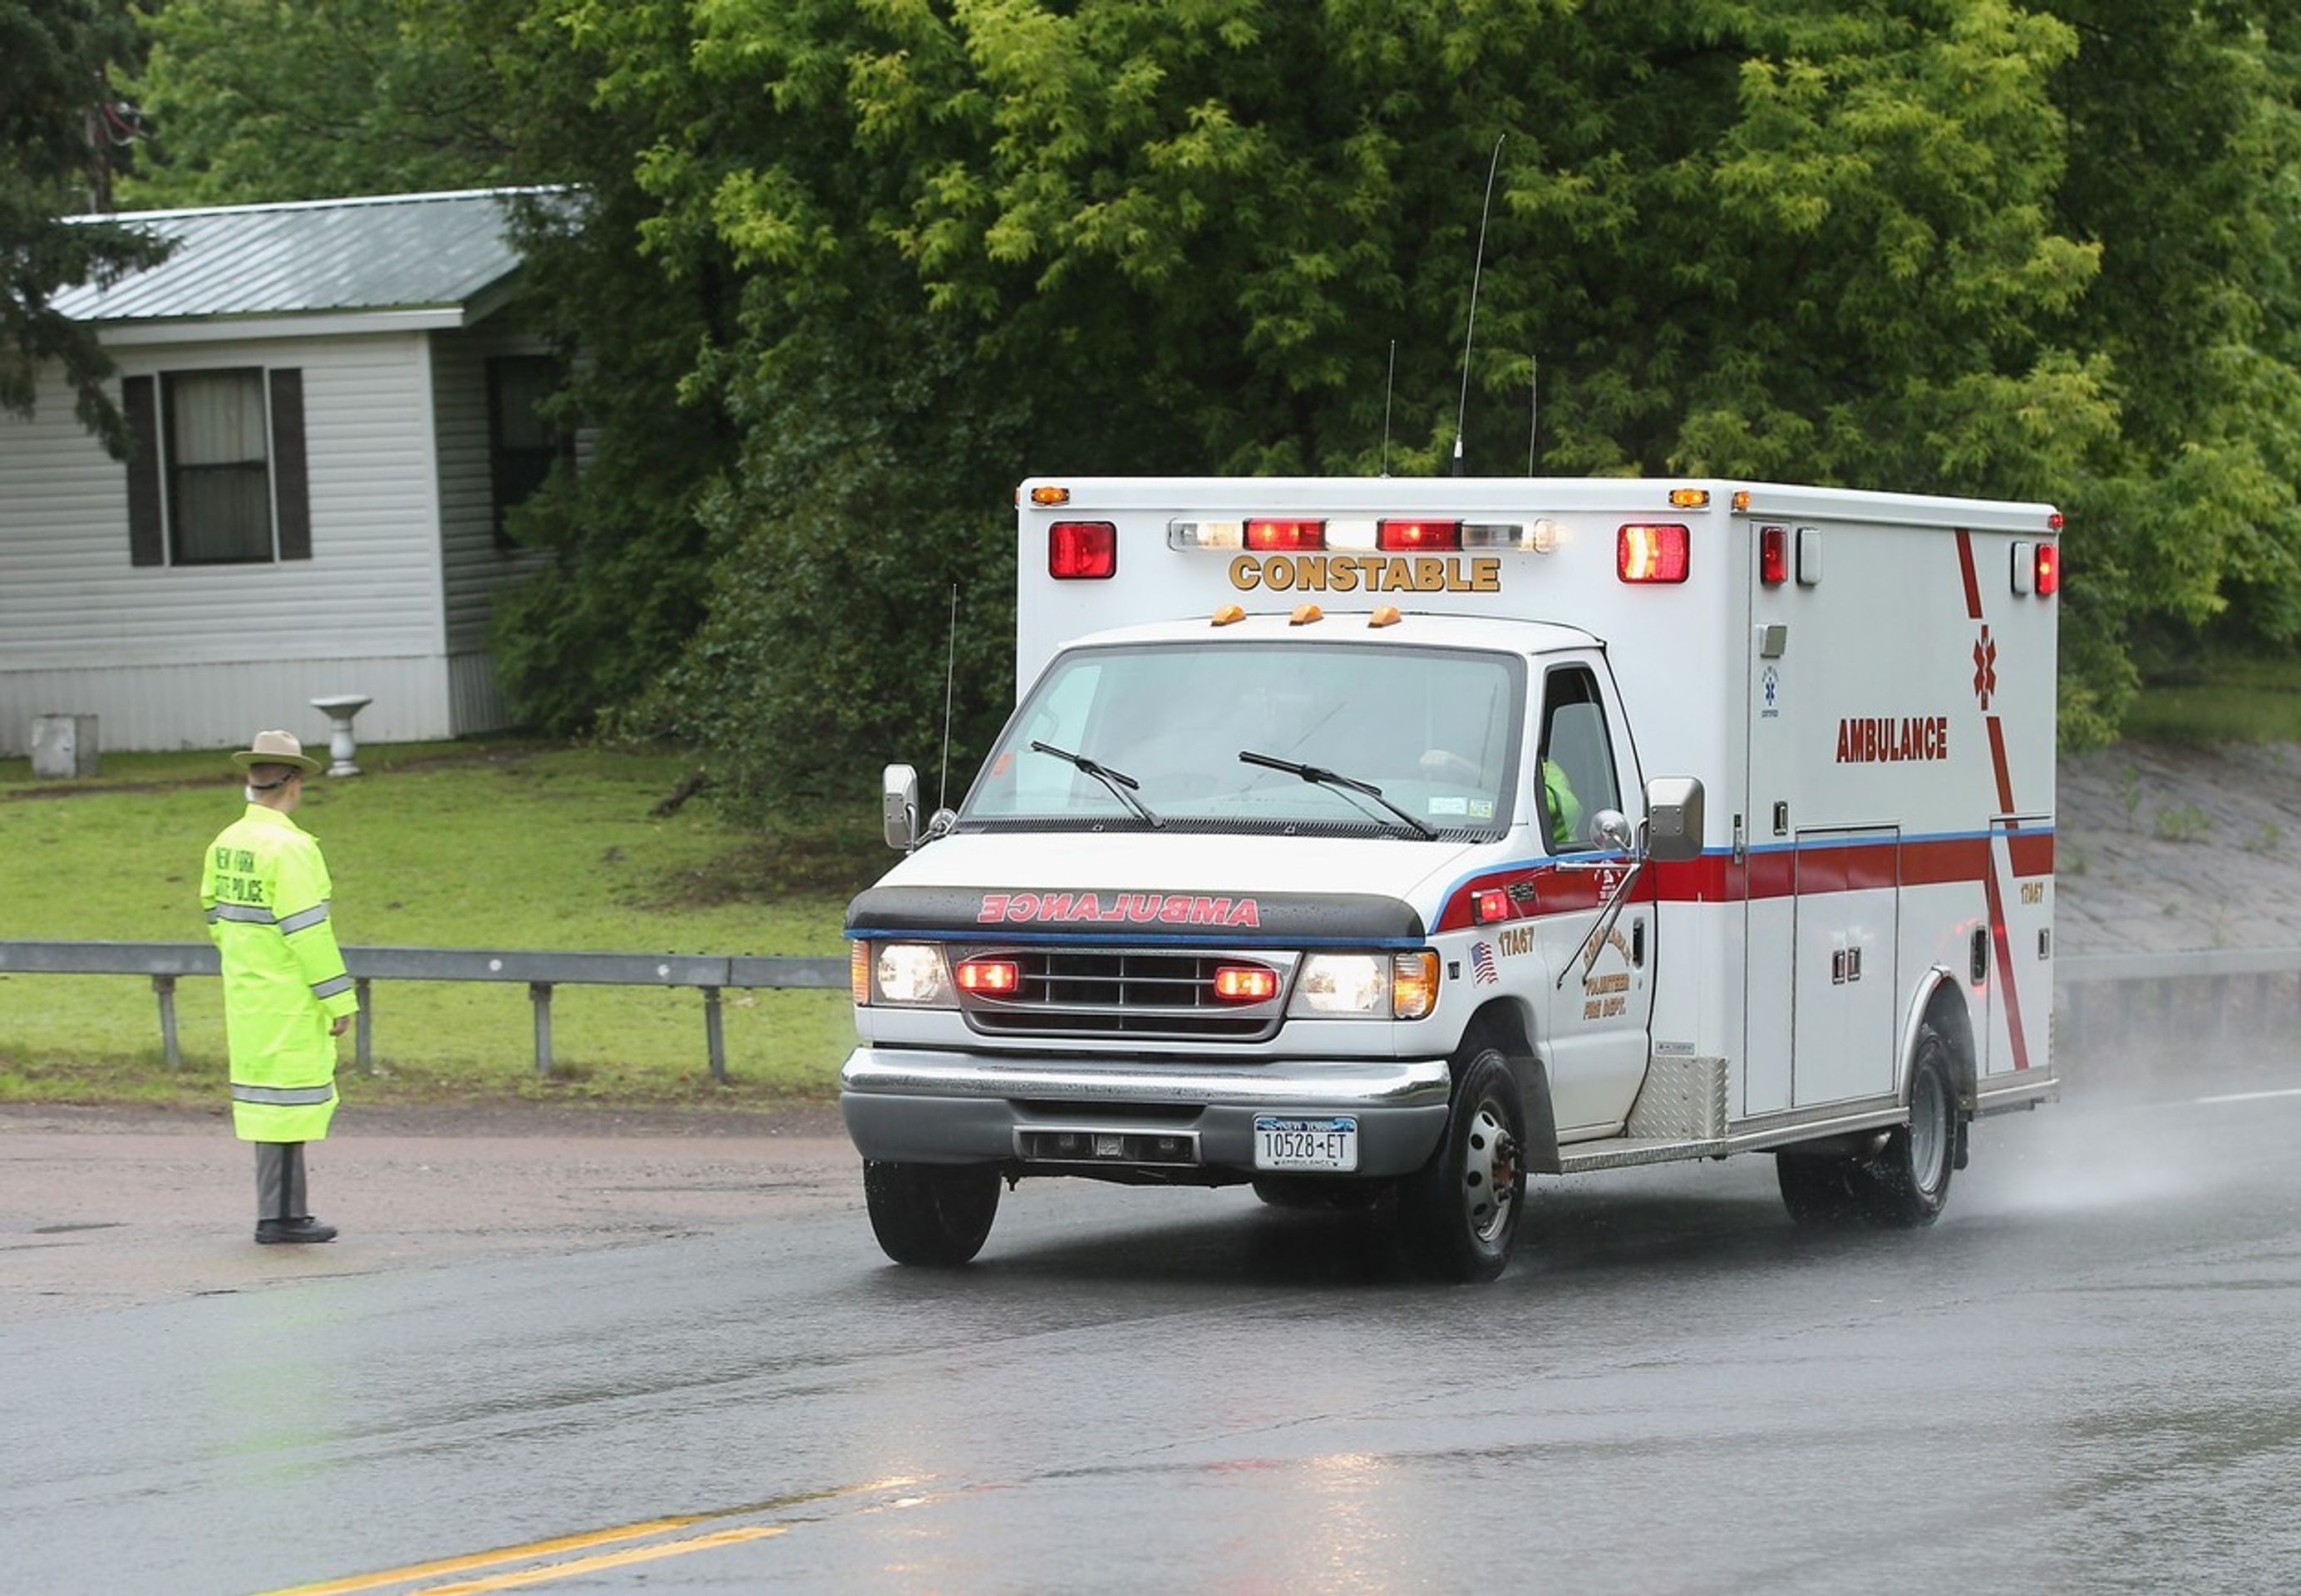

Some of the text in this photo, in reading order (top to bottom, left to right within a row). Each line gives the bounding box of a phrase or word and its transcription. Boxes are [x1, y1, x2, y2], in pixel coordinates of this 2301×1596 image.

[1229, 555, 1501, 593] CONSTABLE
[1835, 717, 1948, 763] AMBULANCE
[232, 878, 264, 903] POLICE
[1498, 925, 1535, 957] 17A67
